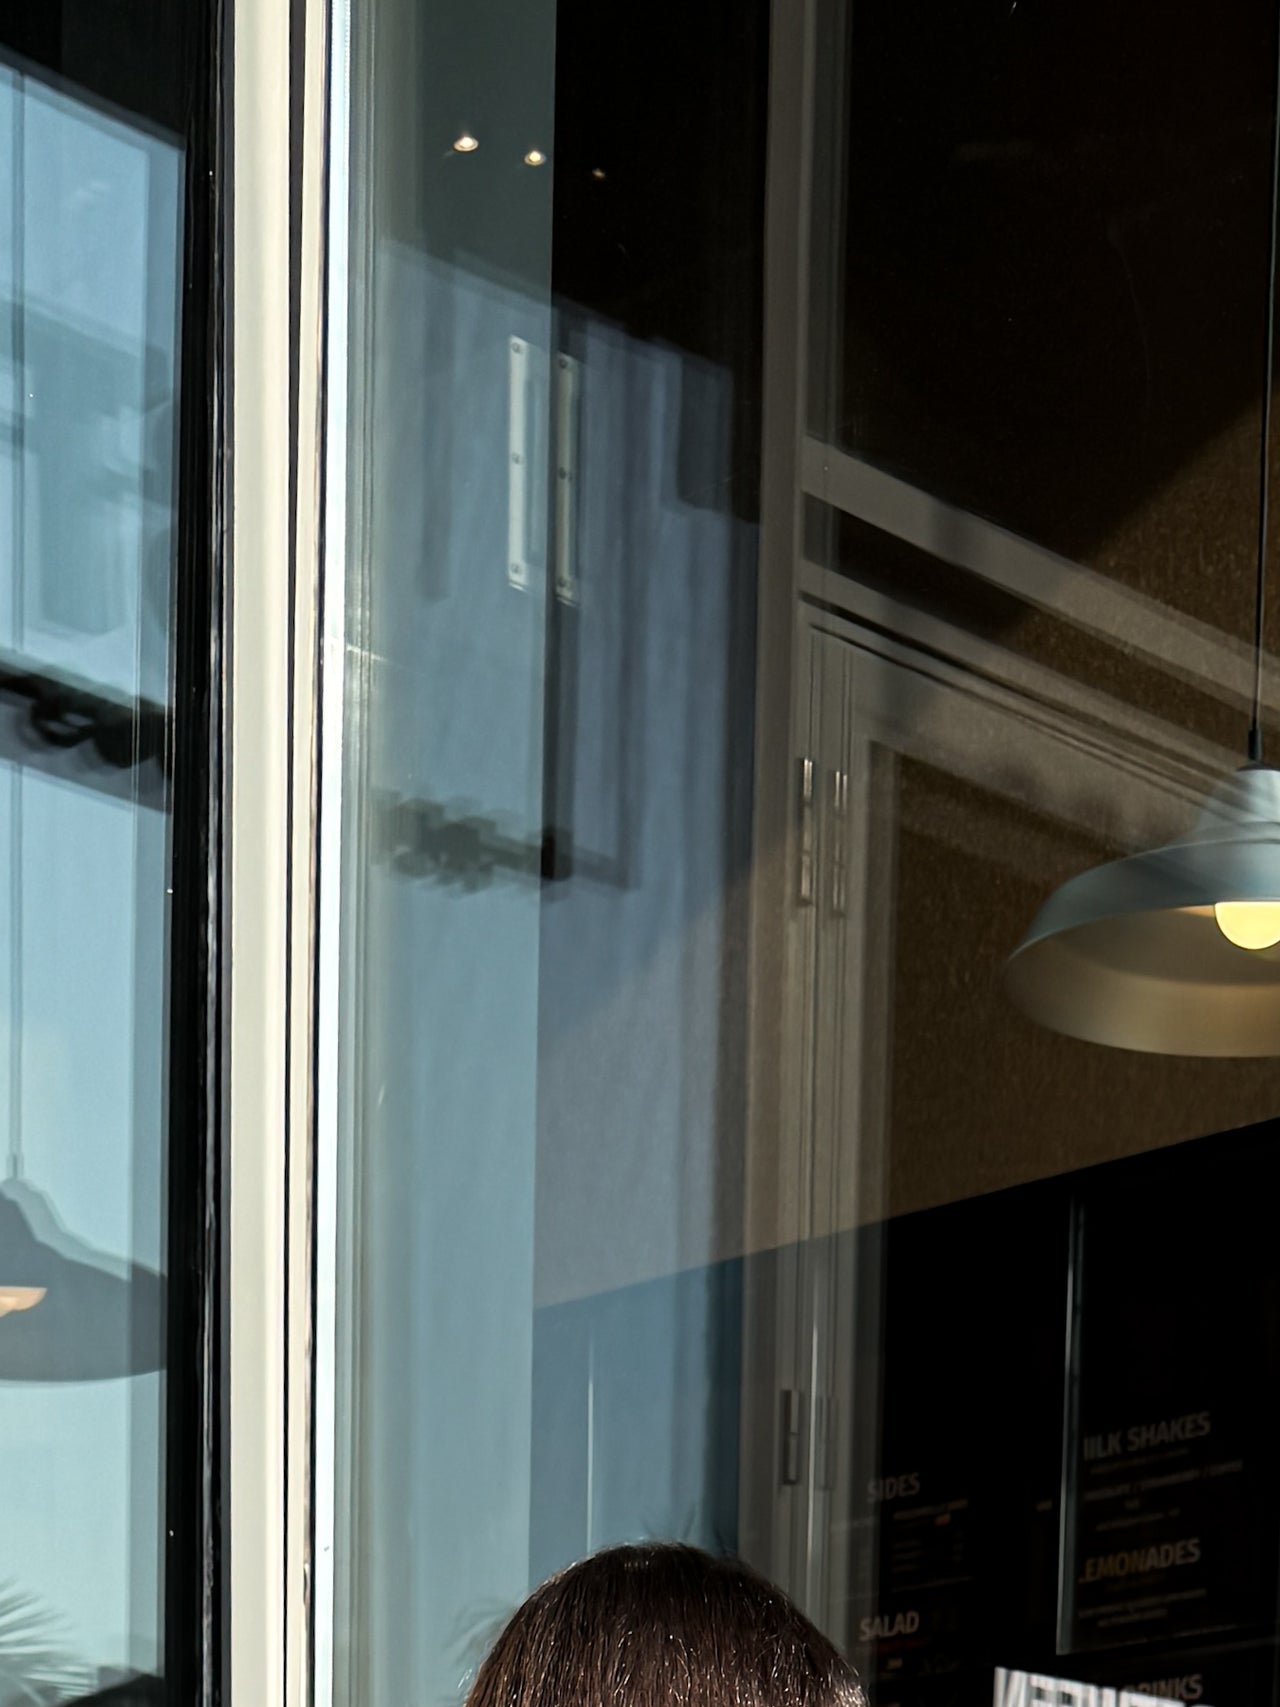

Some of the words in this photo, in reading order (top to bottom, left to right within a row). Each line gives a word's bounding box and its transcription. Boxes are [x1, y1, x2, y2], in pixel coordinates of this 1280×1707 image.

[1127, 1409, 1213, 1451] SHAKES
[1078, 1536, 1203, 1584] EMONADES
[859, 1609, 921, 1642] SALAD
